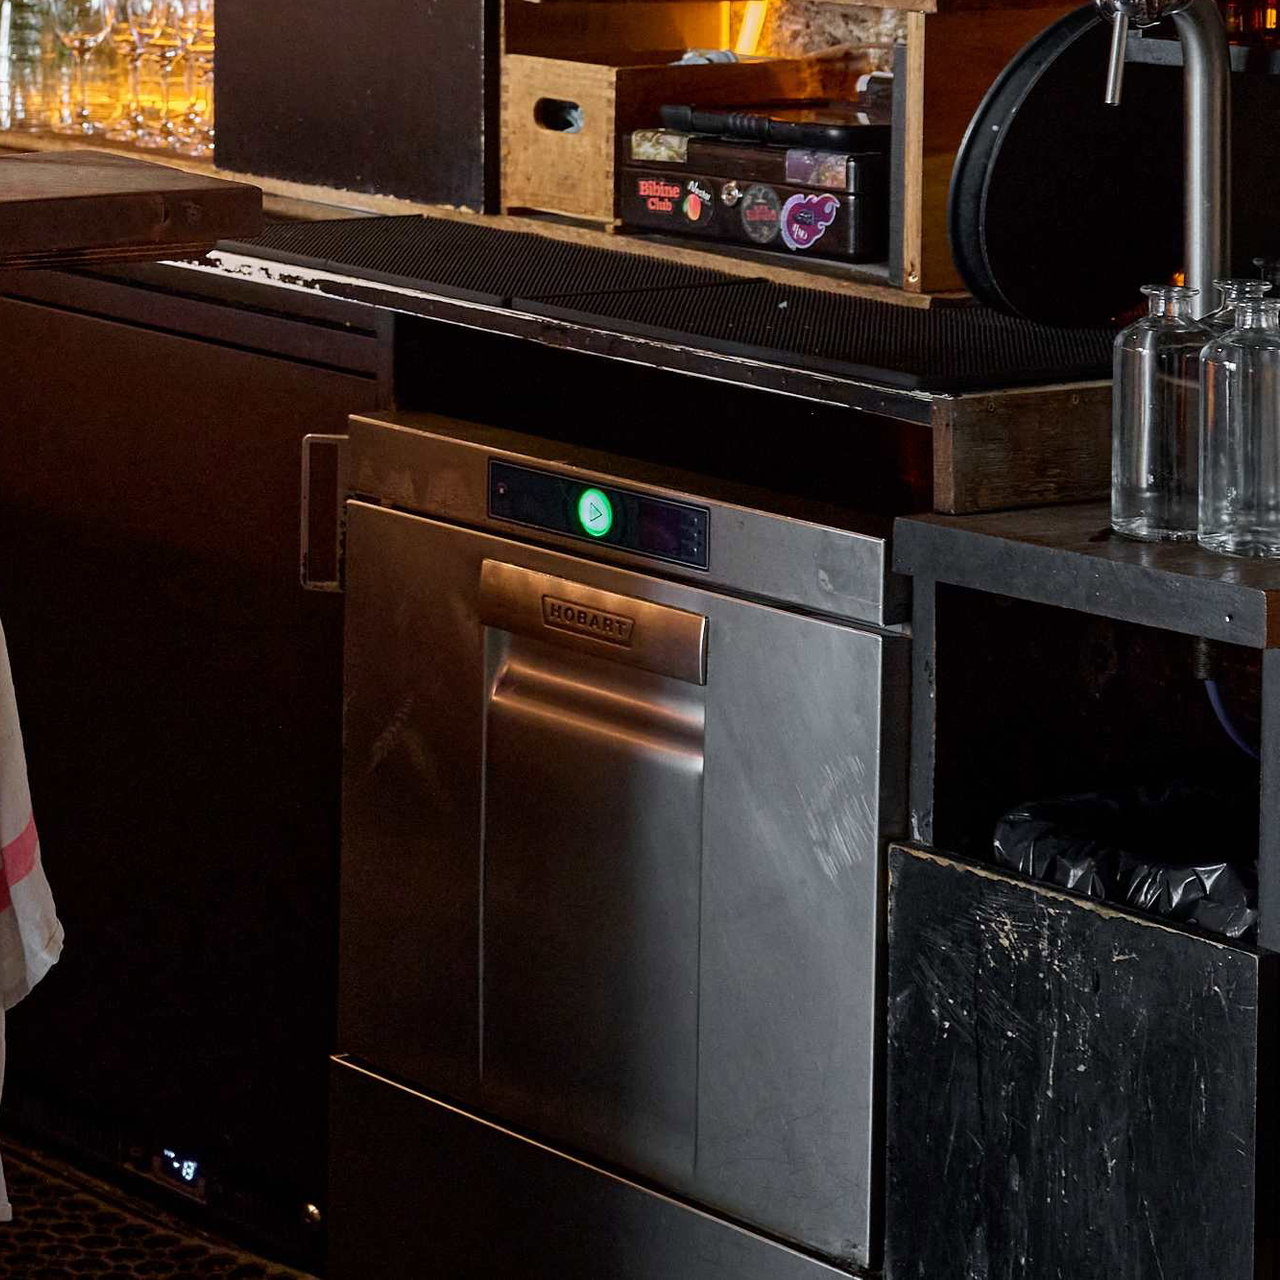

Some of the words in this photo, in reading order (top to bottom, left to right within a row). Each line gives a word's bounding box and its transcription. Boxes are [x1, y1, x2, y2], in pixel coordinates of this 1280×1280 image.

[638, 181, 681, 198] Bibine
[647, 197, 673, 212] Club
[550, 603, 626, 636] HOBART
